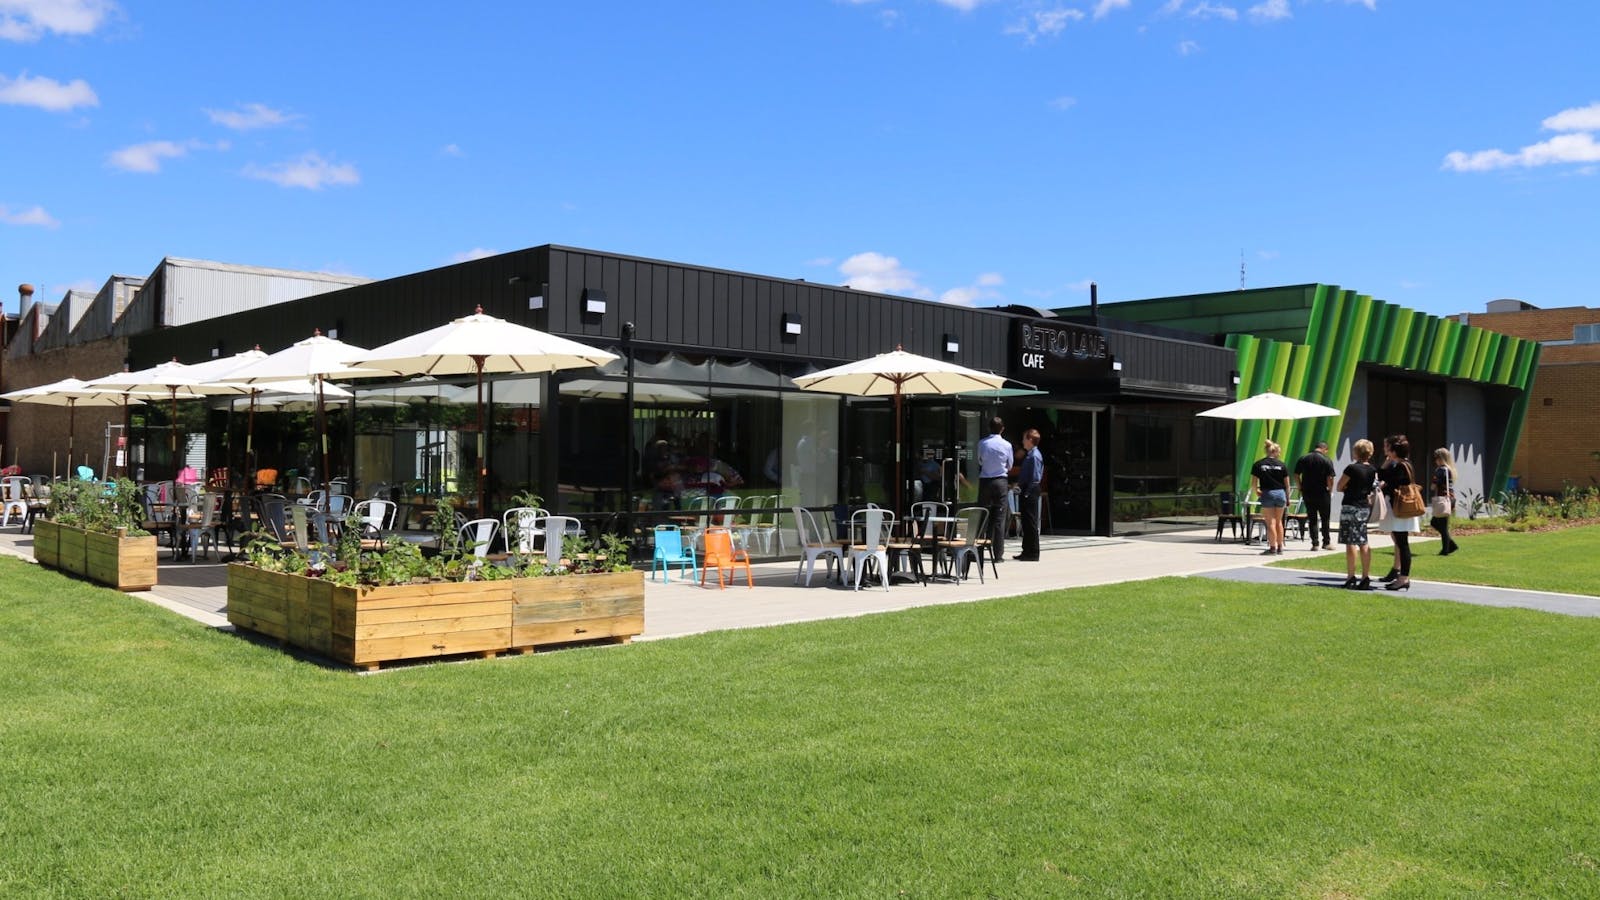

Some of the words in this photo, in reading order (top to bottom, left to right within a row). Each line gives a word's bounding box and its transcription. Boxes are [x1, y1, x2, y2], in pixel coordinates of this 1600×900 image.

[1022, 324, 1068, 354] RETRO
[1072, 331, 1106, 359] LANE
[1022, 353, 1044, 369] CAFE
